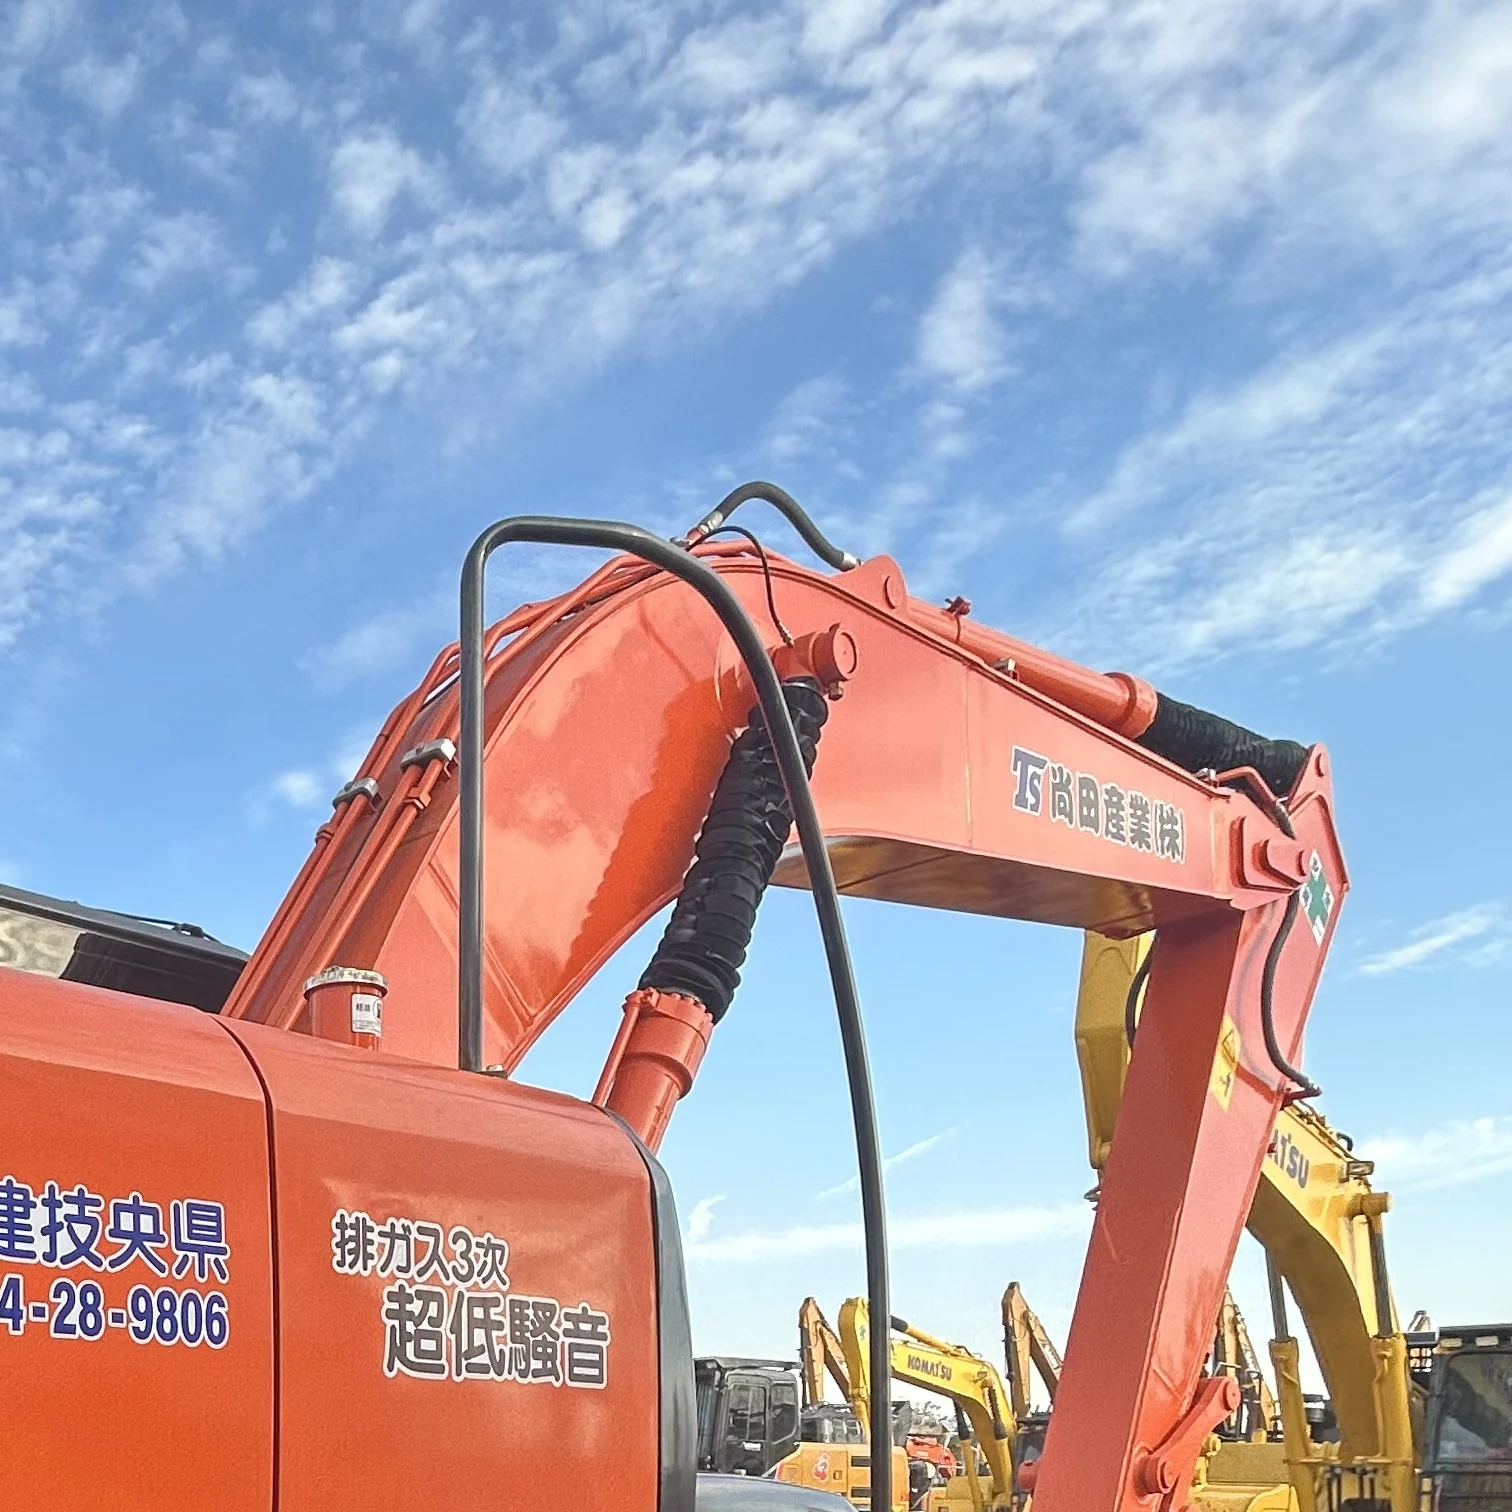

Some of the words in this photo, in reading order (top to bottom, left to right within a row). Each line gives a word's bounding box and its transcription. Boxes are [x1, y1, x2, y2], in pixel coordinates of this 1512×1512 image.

[334, 1213, 508, 1287] 排ガス3次
[908, 1354, 953, 1382] KOMATSU
